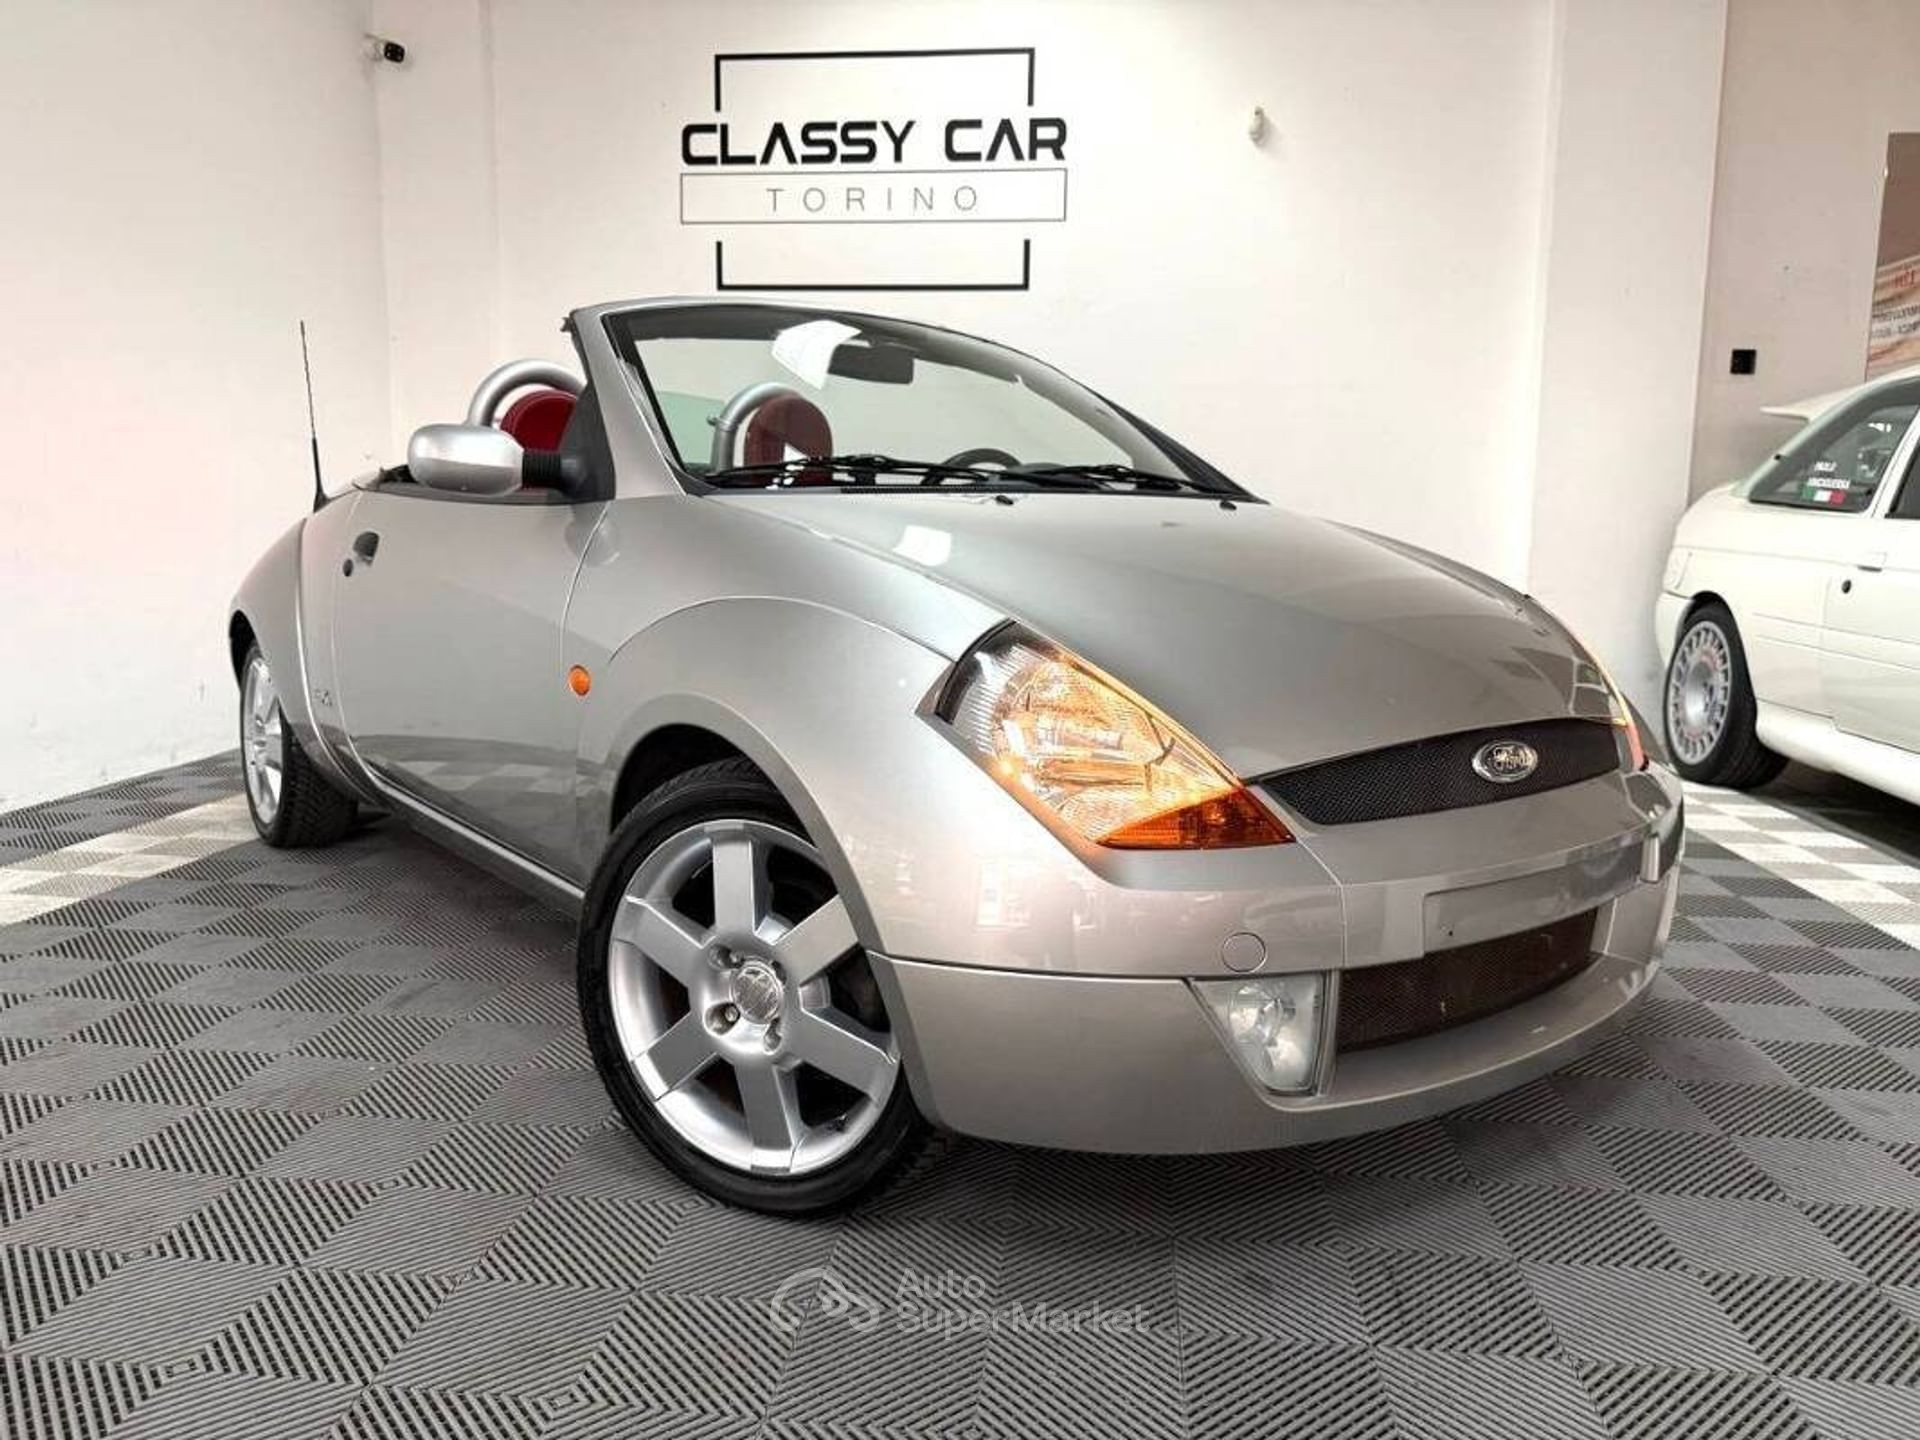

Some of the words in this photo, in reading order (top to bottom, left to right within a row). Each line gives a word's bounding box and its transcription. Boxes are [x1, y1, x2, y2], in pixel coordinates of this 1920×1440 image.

[681, 121, 916, 166] CLASSY
[944, 118, 1068, 162] CAR
[766, 185, 978, 212] TORINO
